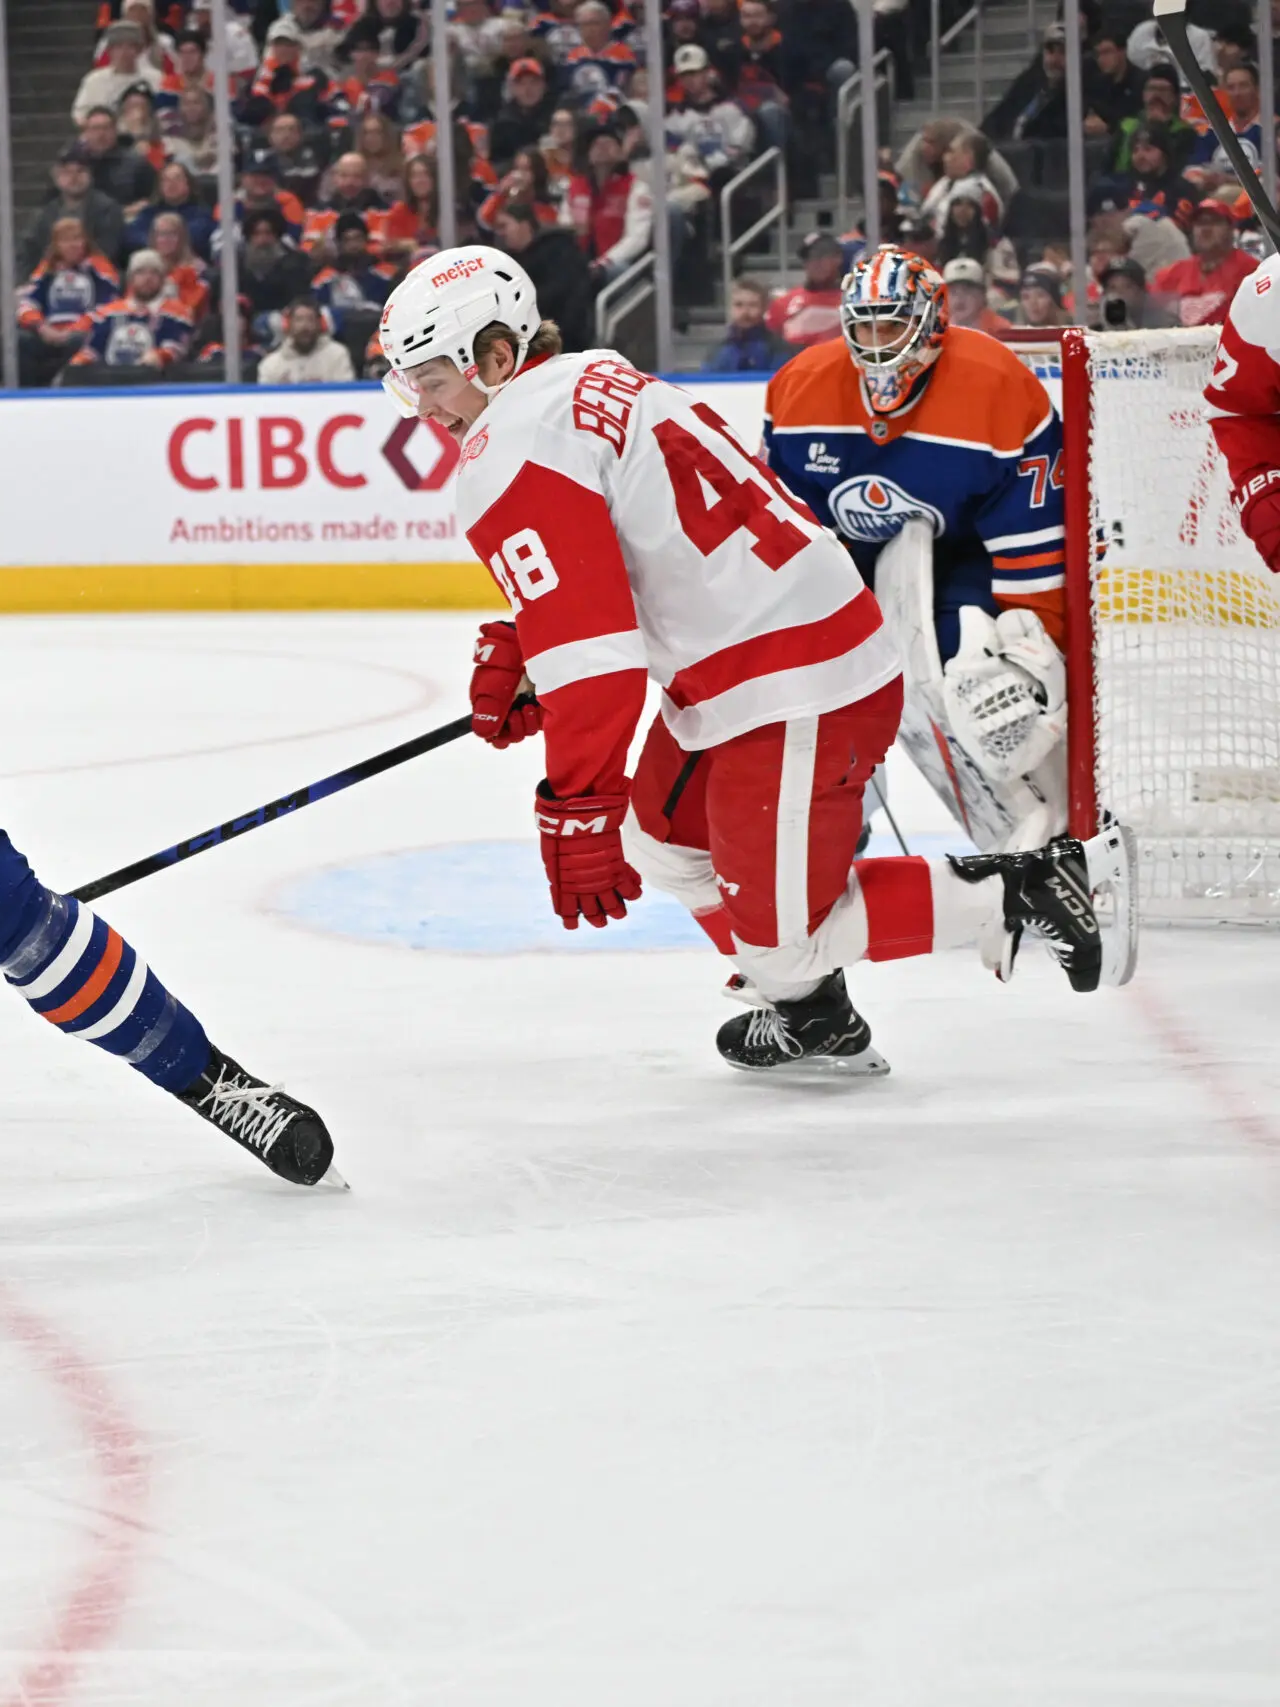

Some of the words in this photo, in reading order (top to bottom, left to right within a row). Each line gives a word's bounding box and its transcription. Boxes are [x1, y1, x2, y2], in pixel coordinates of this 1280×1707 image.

[431, 257, 484, 288] meijer
[573, 360, 660, 460] BERG
[167, 413, 369, 492] CIBC
[170, 516, 314, 543] Ambitions
[322, 516, 399, 541] made
[406, 514, 456, 540] real
[1045, 876, 1099, 935] CCM
